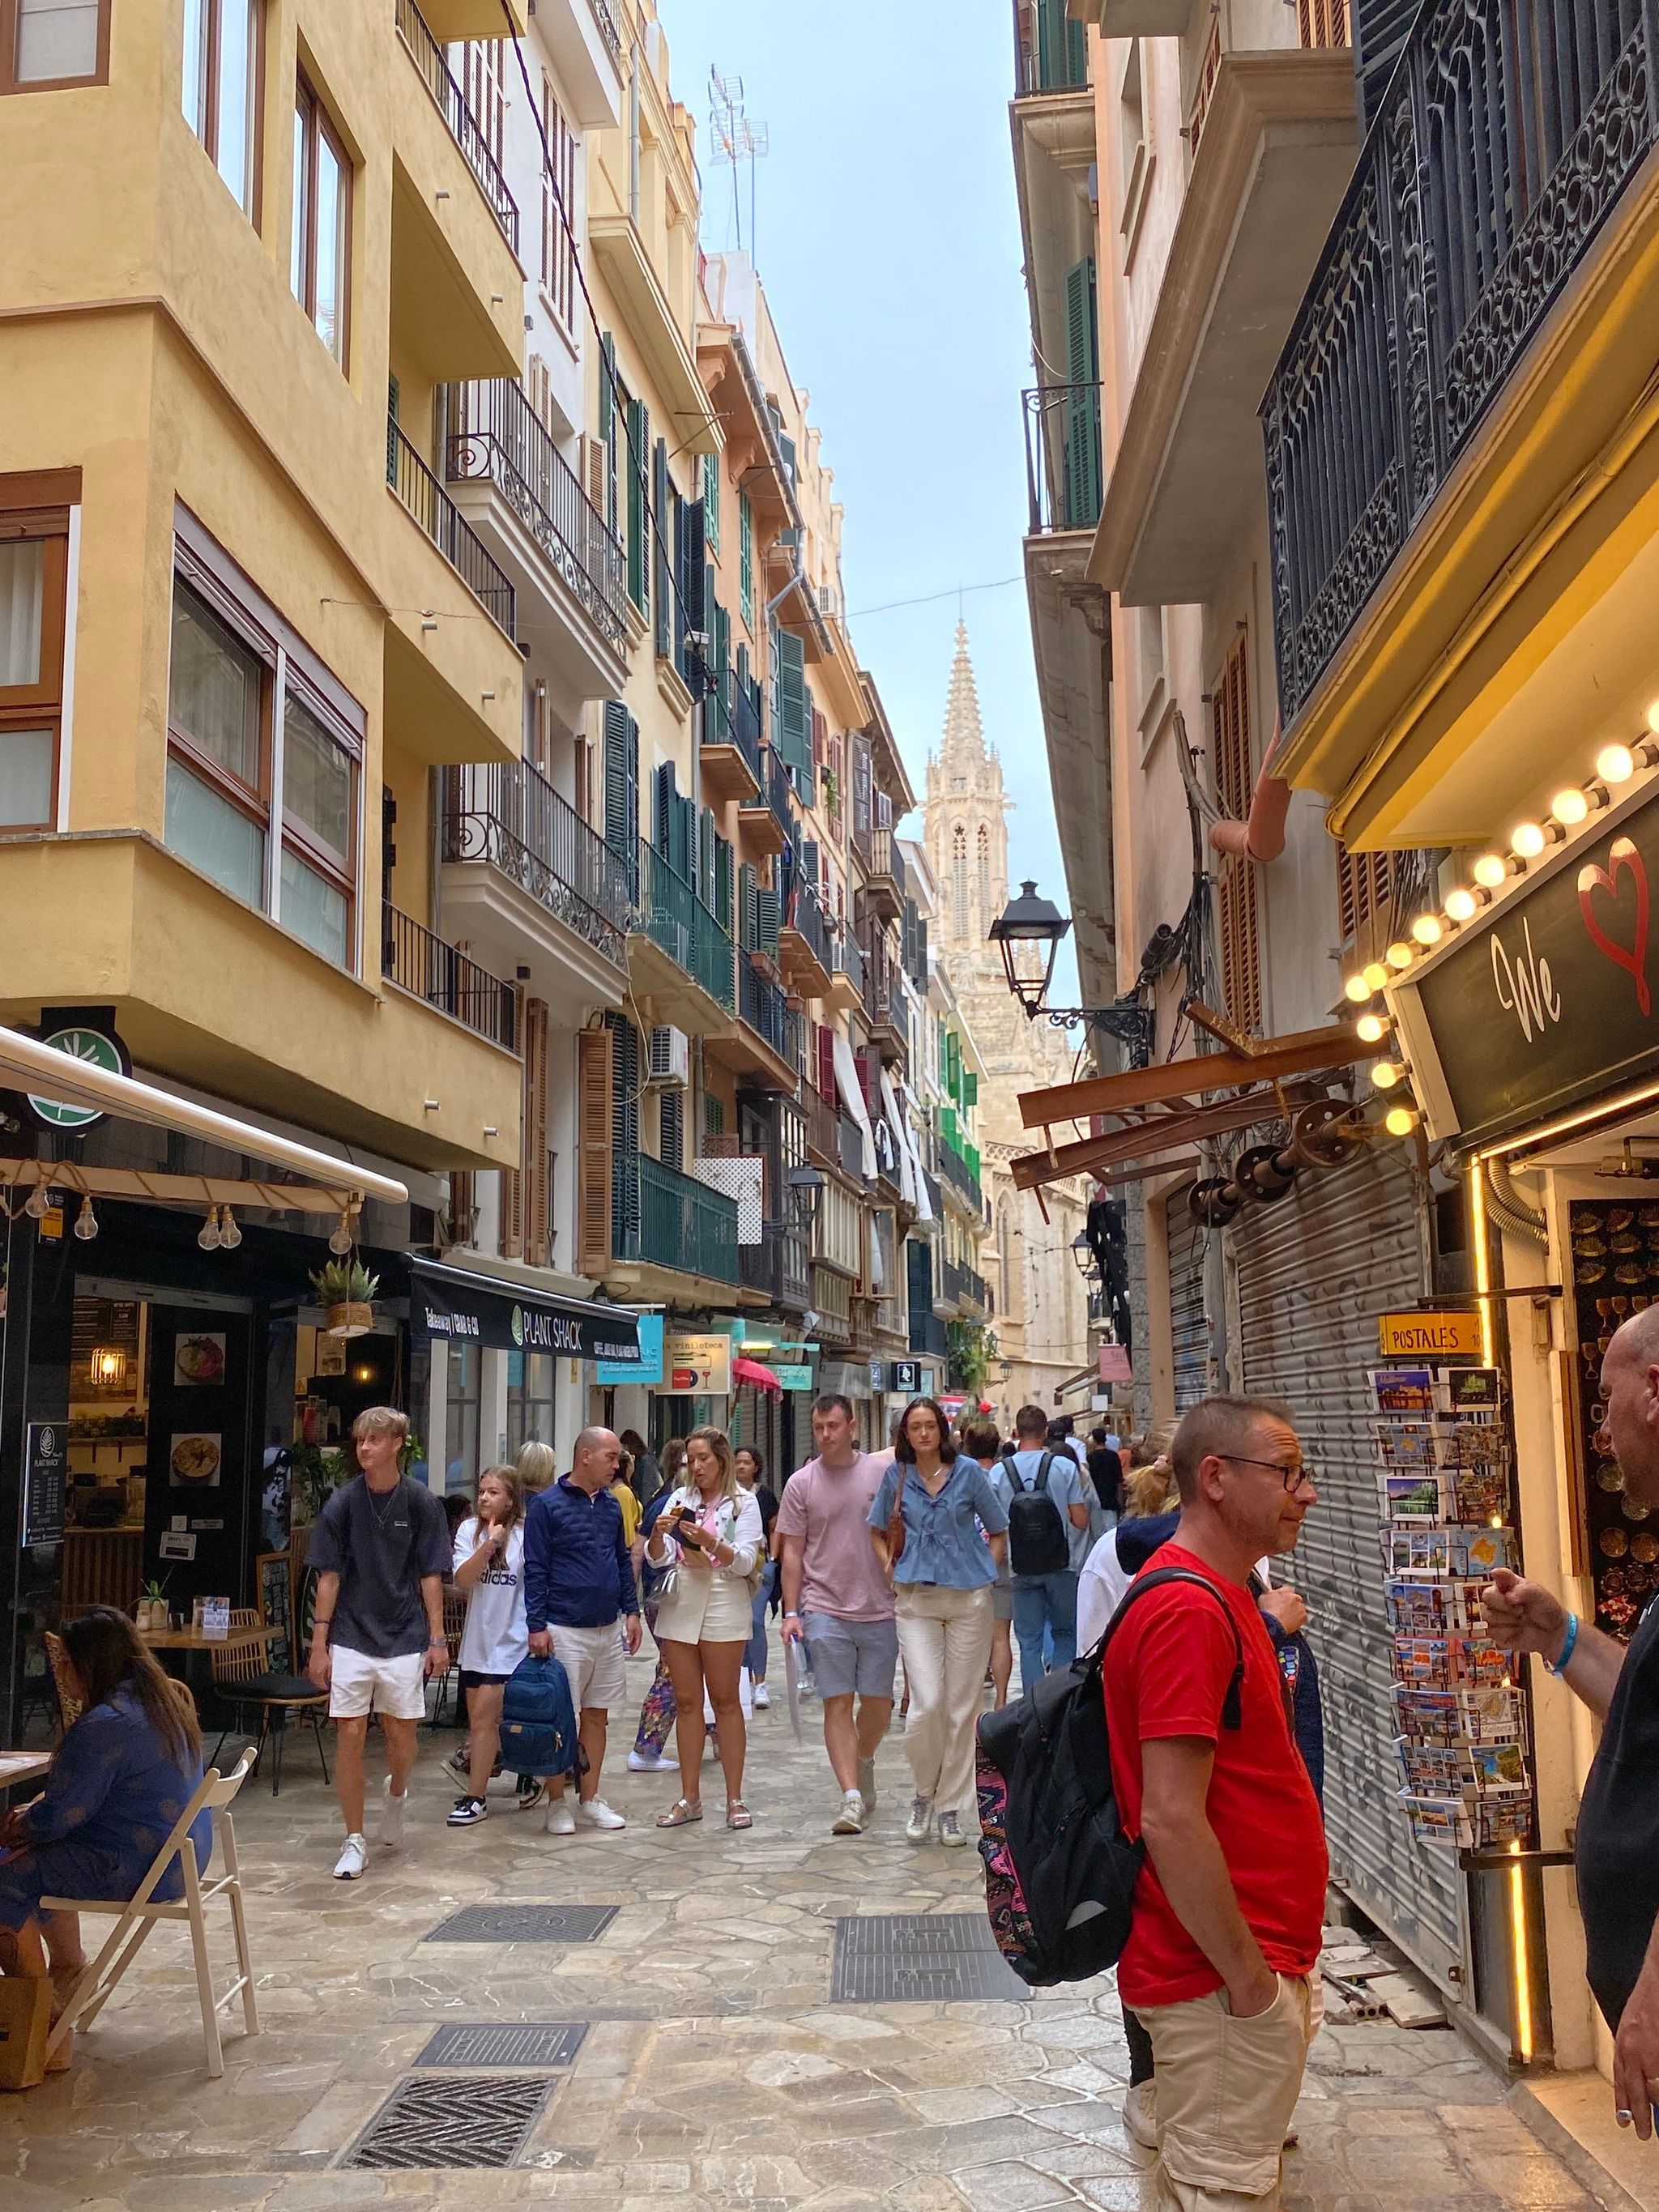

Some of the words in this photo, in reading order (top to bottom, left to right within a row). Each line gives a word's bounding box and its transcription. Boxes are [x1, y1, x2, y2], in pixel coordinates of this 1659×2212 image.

[1491, 916, 1560, 1043] We
[424, 1306, 452, 1336] Takeaway
[523, 1311, 552, 1346] PLANT
[552, 1317, 582, 1350] SHACK
[674, 1340, 723, 1350] viniloteca
[1392, 1327, 1459, 1349] POSTALES
[480, 1569, 517, 1586] didas
